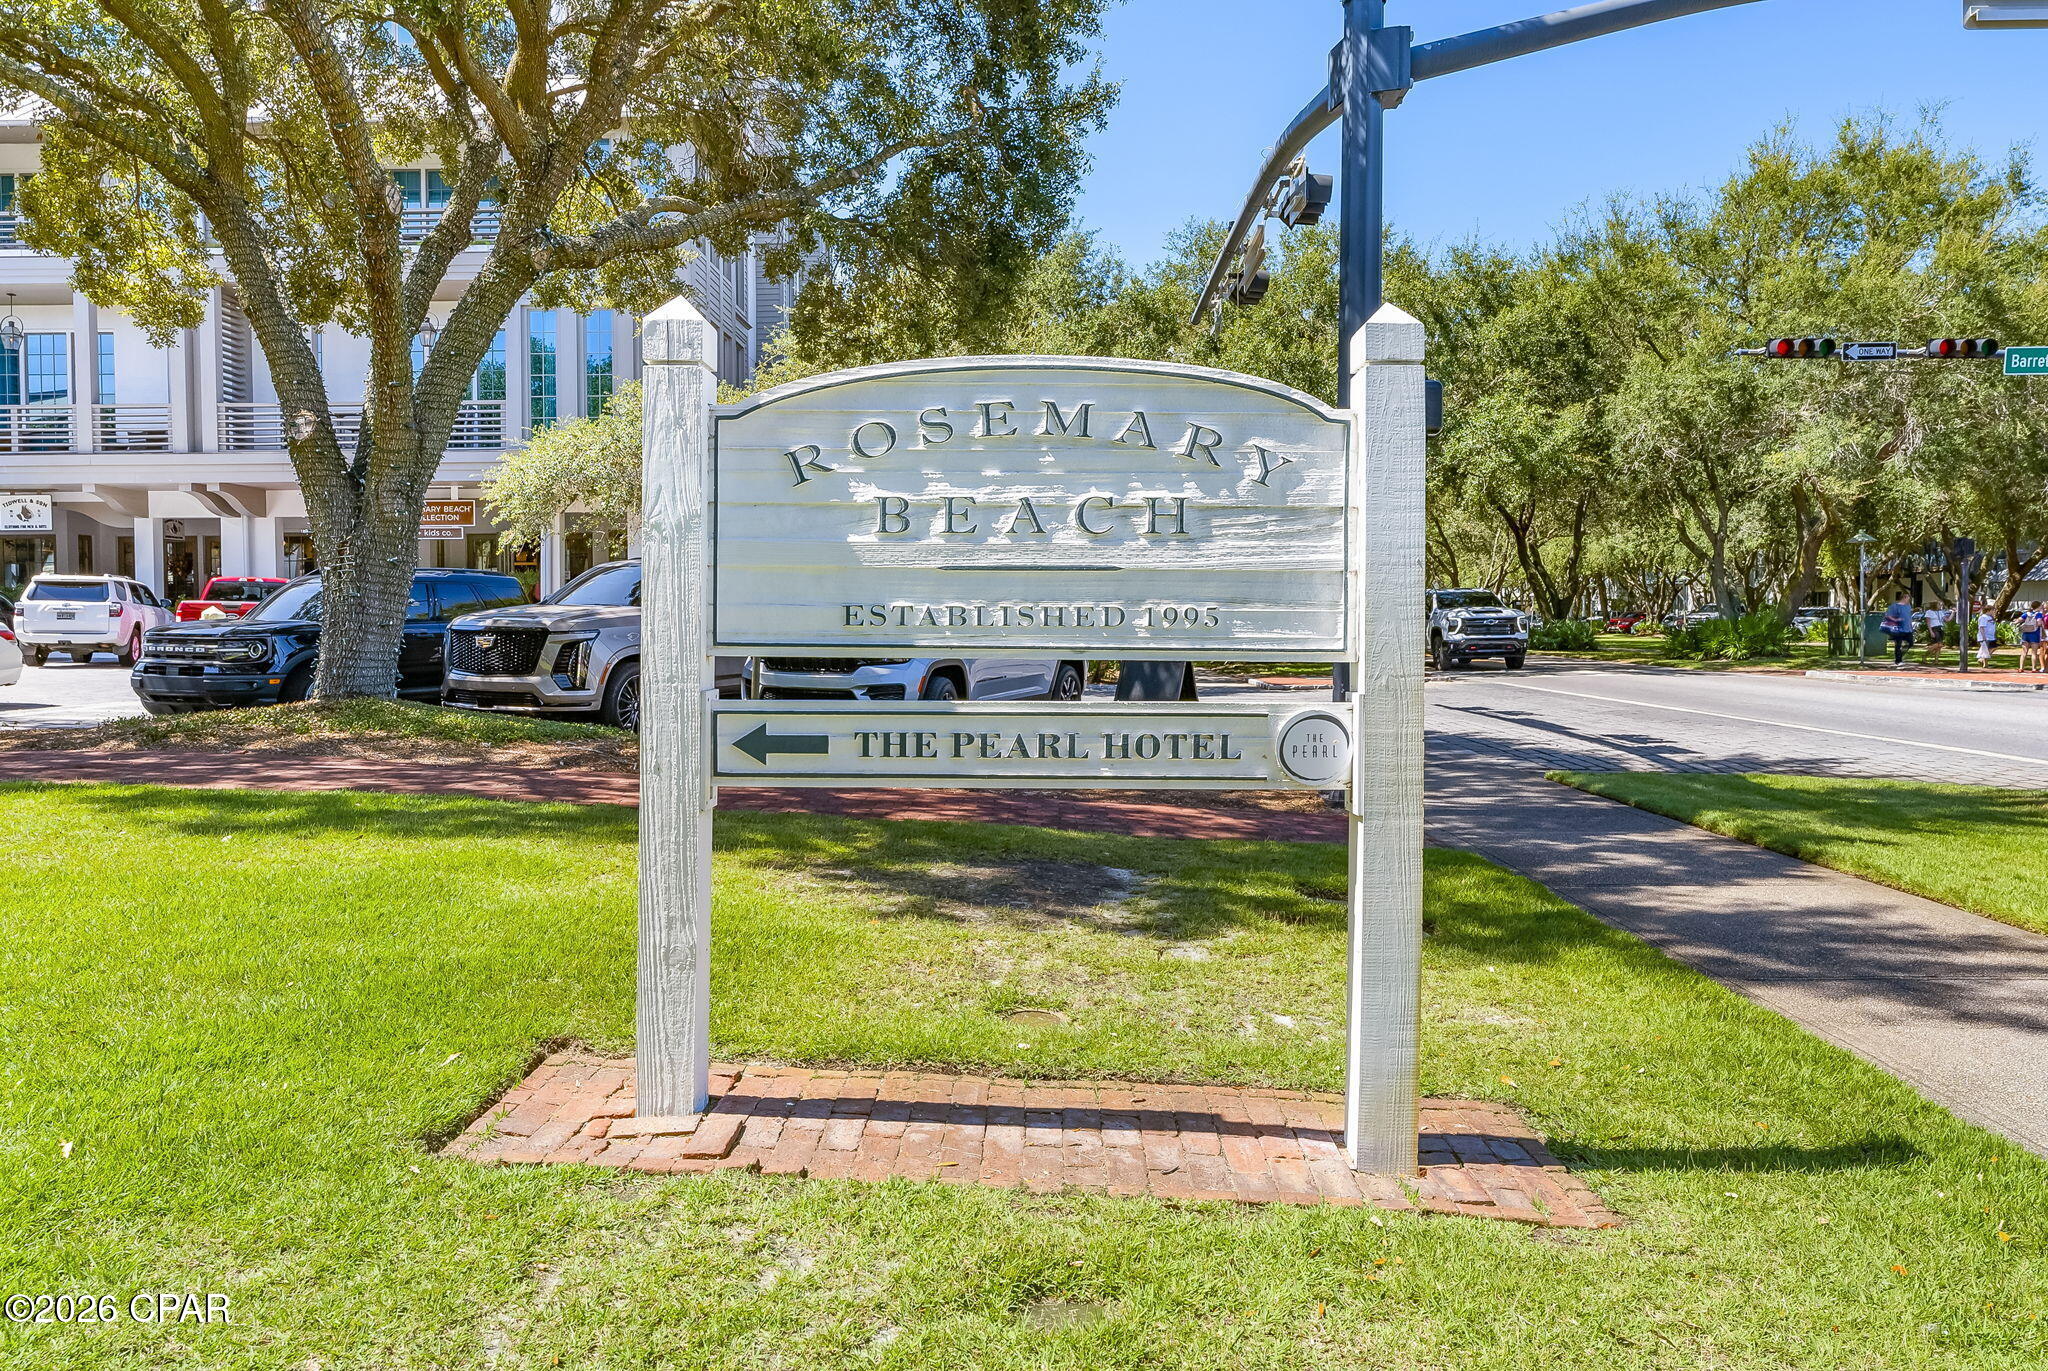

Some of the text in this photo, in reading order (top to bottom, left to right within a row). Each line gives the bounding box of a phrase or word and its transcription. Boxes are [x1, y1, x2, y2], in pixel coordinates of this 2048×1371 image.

[1875, 347, 1891, 355] WAY
[784, 400, 1294, 487] ROSEMARY
[874, 496, 1189, 535] BEACH
[842, 604, 1219, 628] ESTABLISHED 1995
[854, 731, 1242, 760] THE PEARL HOTEL
[1306, 733, 1324, 743] THE
[1292, 744, 1338, 758] PEARL
